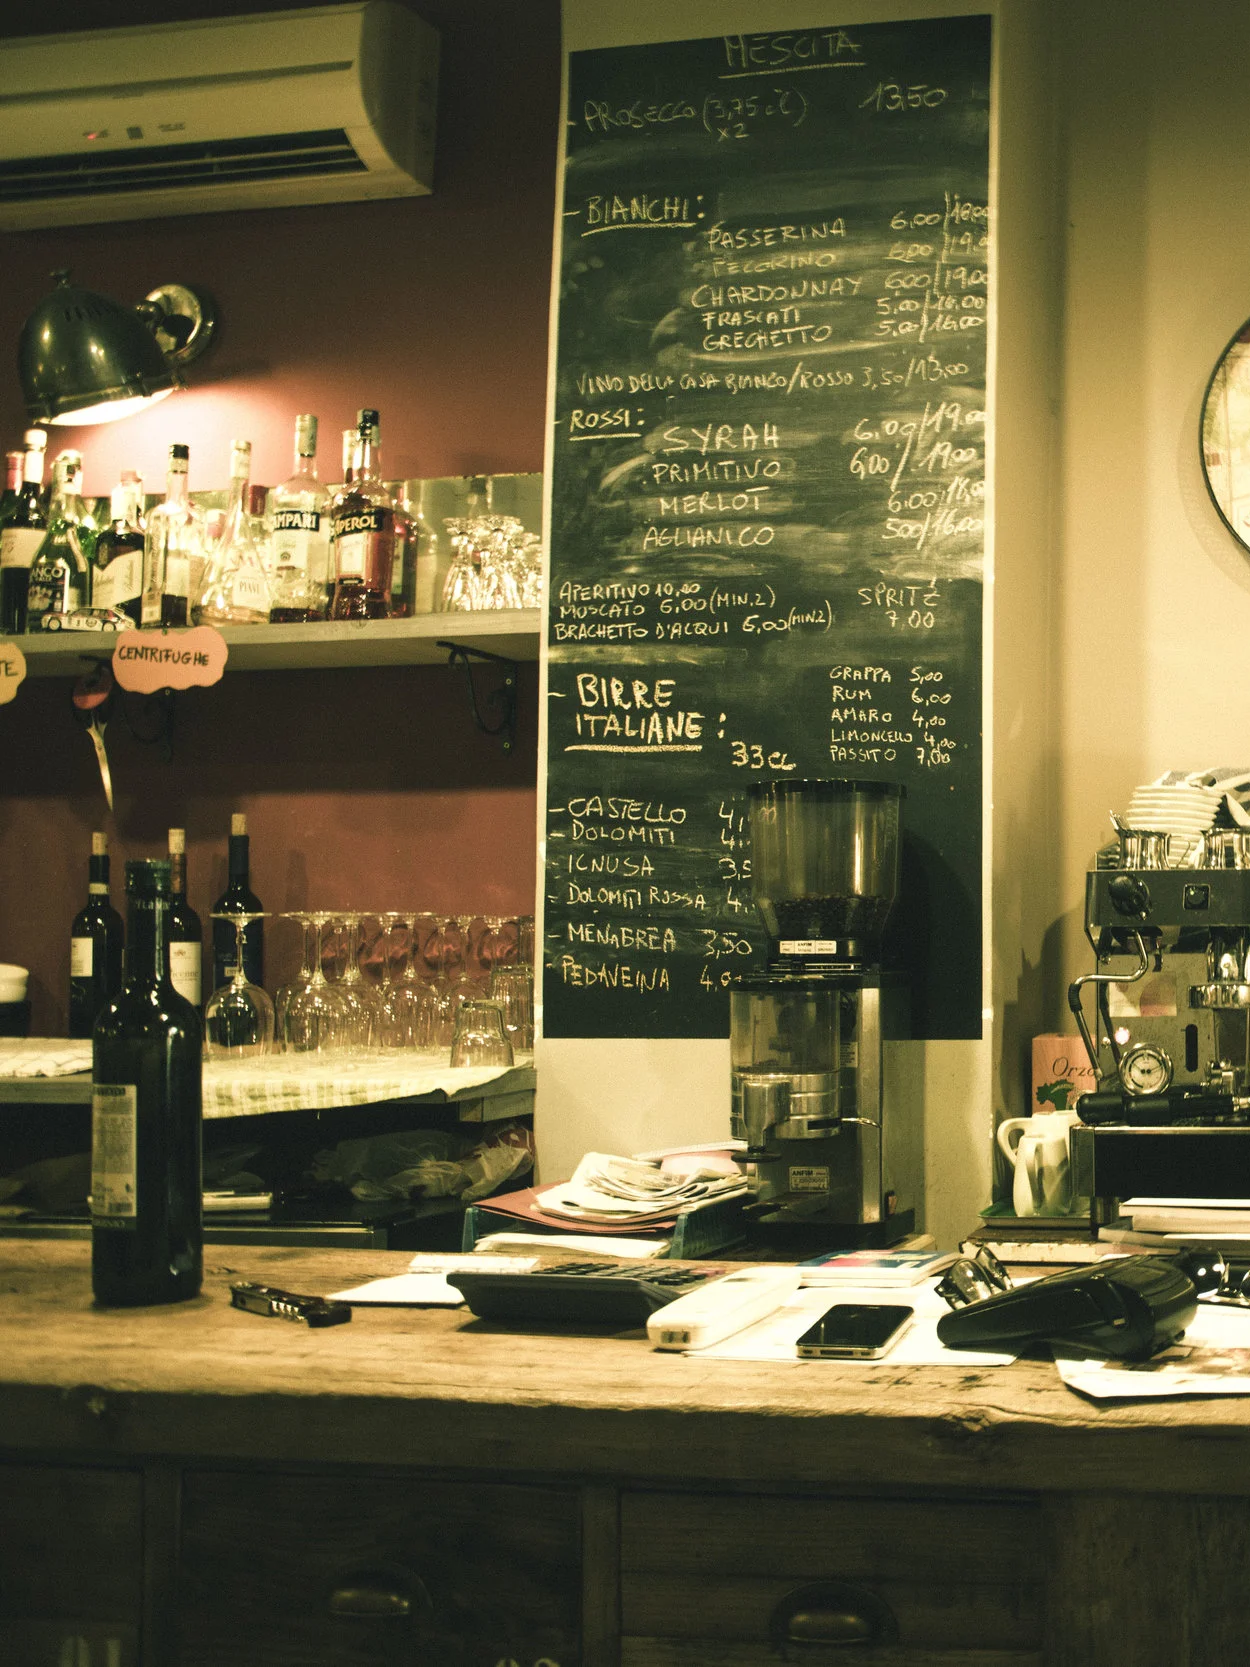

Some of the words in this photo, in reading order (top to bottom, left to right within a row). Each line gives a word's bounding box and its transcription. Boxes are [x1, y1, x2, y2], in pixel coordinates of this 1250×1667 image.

[723, 31, 862, 68] MESCITA
[587, 195, 705, 224] BIANCHI:
[707, 220, 847, 252] PASSERINA
[692, 276, 863, 308] CHARDONNAY
[702, 306, 800, 330] FRASCATI
[703, 324, 832, 352] GRECHETTO
[577, 371, 623, 396] VINO
[569, 408, 645, 432] ROSSI:
[662, 422, 780, 455] SYRAH
[652, 459, 781, 484] PRIMITIVO
[660, 486, 771, 515] MERLOT
[643, 526, 775, 550] AGLIANICO
[559, 581, 650, 603] APERITIVO
[858, 577, 941, 608] SPRITZ
[560, 600, 645, 619] MOSCATO
[554, 622, 648, 641] BRACHETTO
[656, 621, 729, 640] D'ACQUI
[118, 645, 210, 667] CENTRIFUGHE
[829, 666, 892, 683] GRAPPA
[576, 673, 677, 710] BIRRE
[832, 685, 872, 702] RUM
[831, 708, 892, 723] AMARO
[831, 728, 913, 743] LIMONCELLO
[829, 745, 897, 763] PASSITO
[568, 797, 687, 824] CASTELLO
[571, 819, 675, 845] DOLOMITI
[566, 883, 643, 910] DOLOMITI
[567, 923, 677, 953] MENABREA
